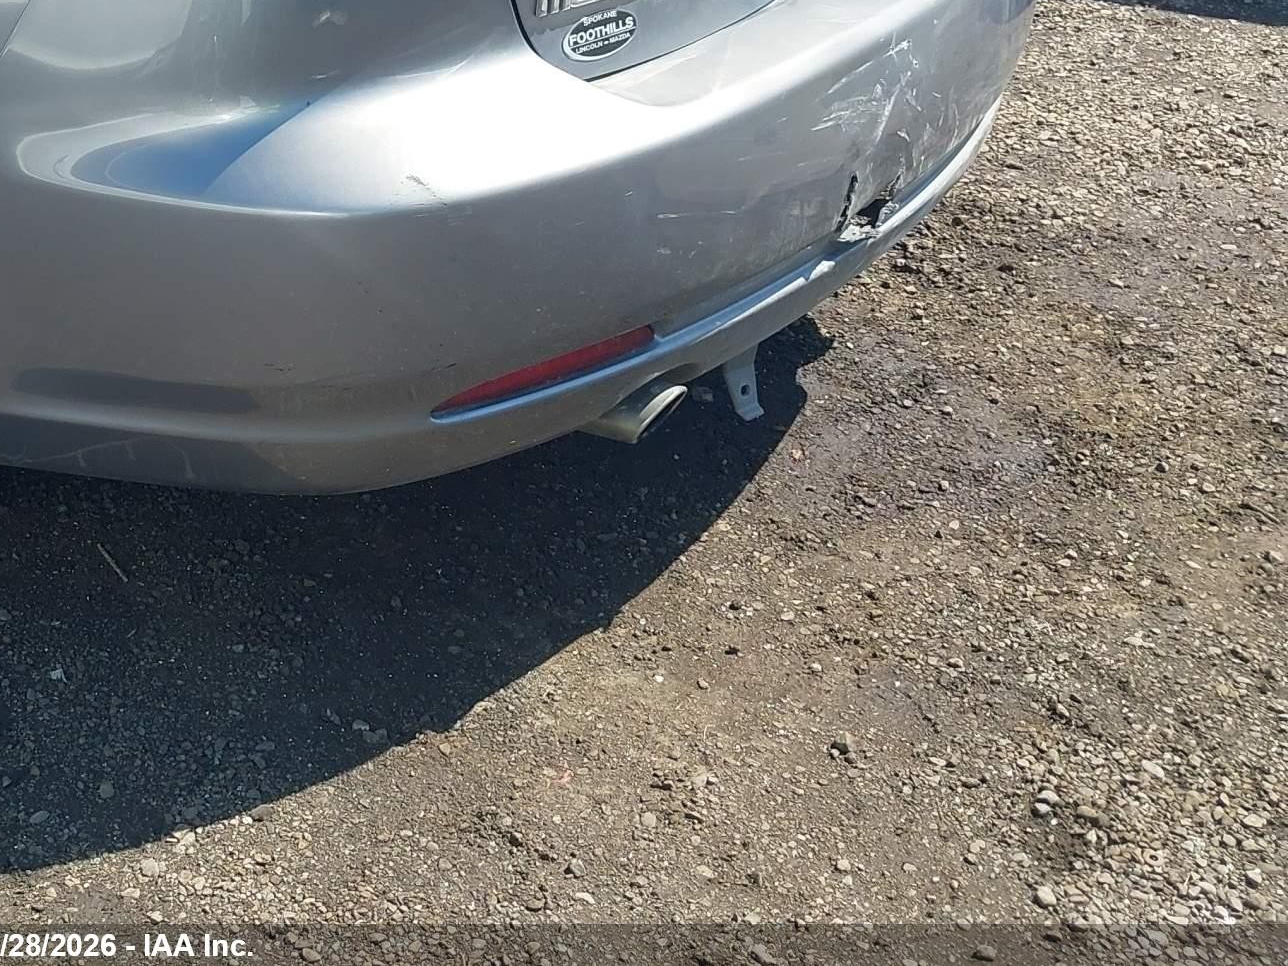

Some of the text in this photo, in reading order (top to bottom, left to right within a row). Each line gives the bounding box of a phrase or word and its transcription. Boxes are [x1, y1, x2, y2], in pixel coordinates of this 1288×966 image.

[583, 10, 617, 27] SPOKANE
[569, 16, 634, 47] FOOTHILLS
[575, 40, 604, 54] LINCOLN
[609, 31, 631, 44] MAZDA
